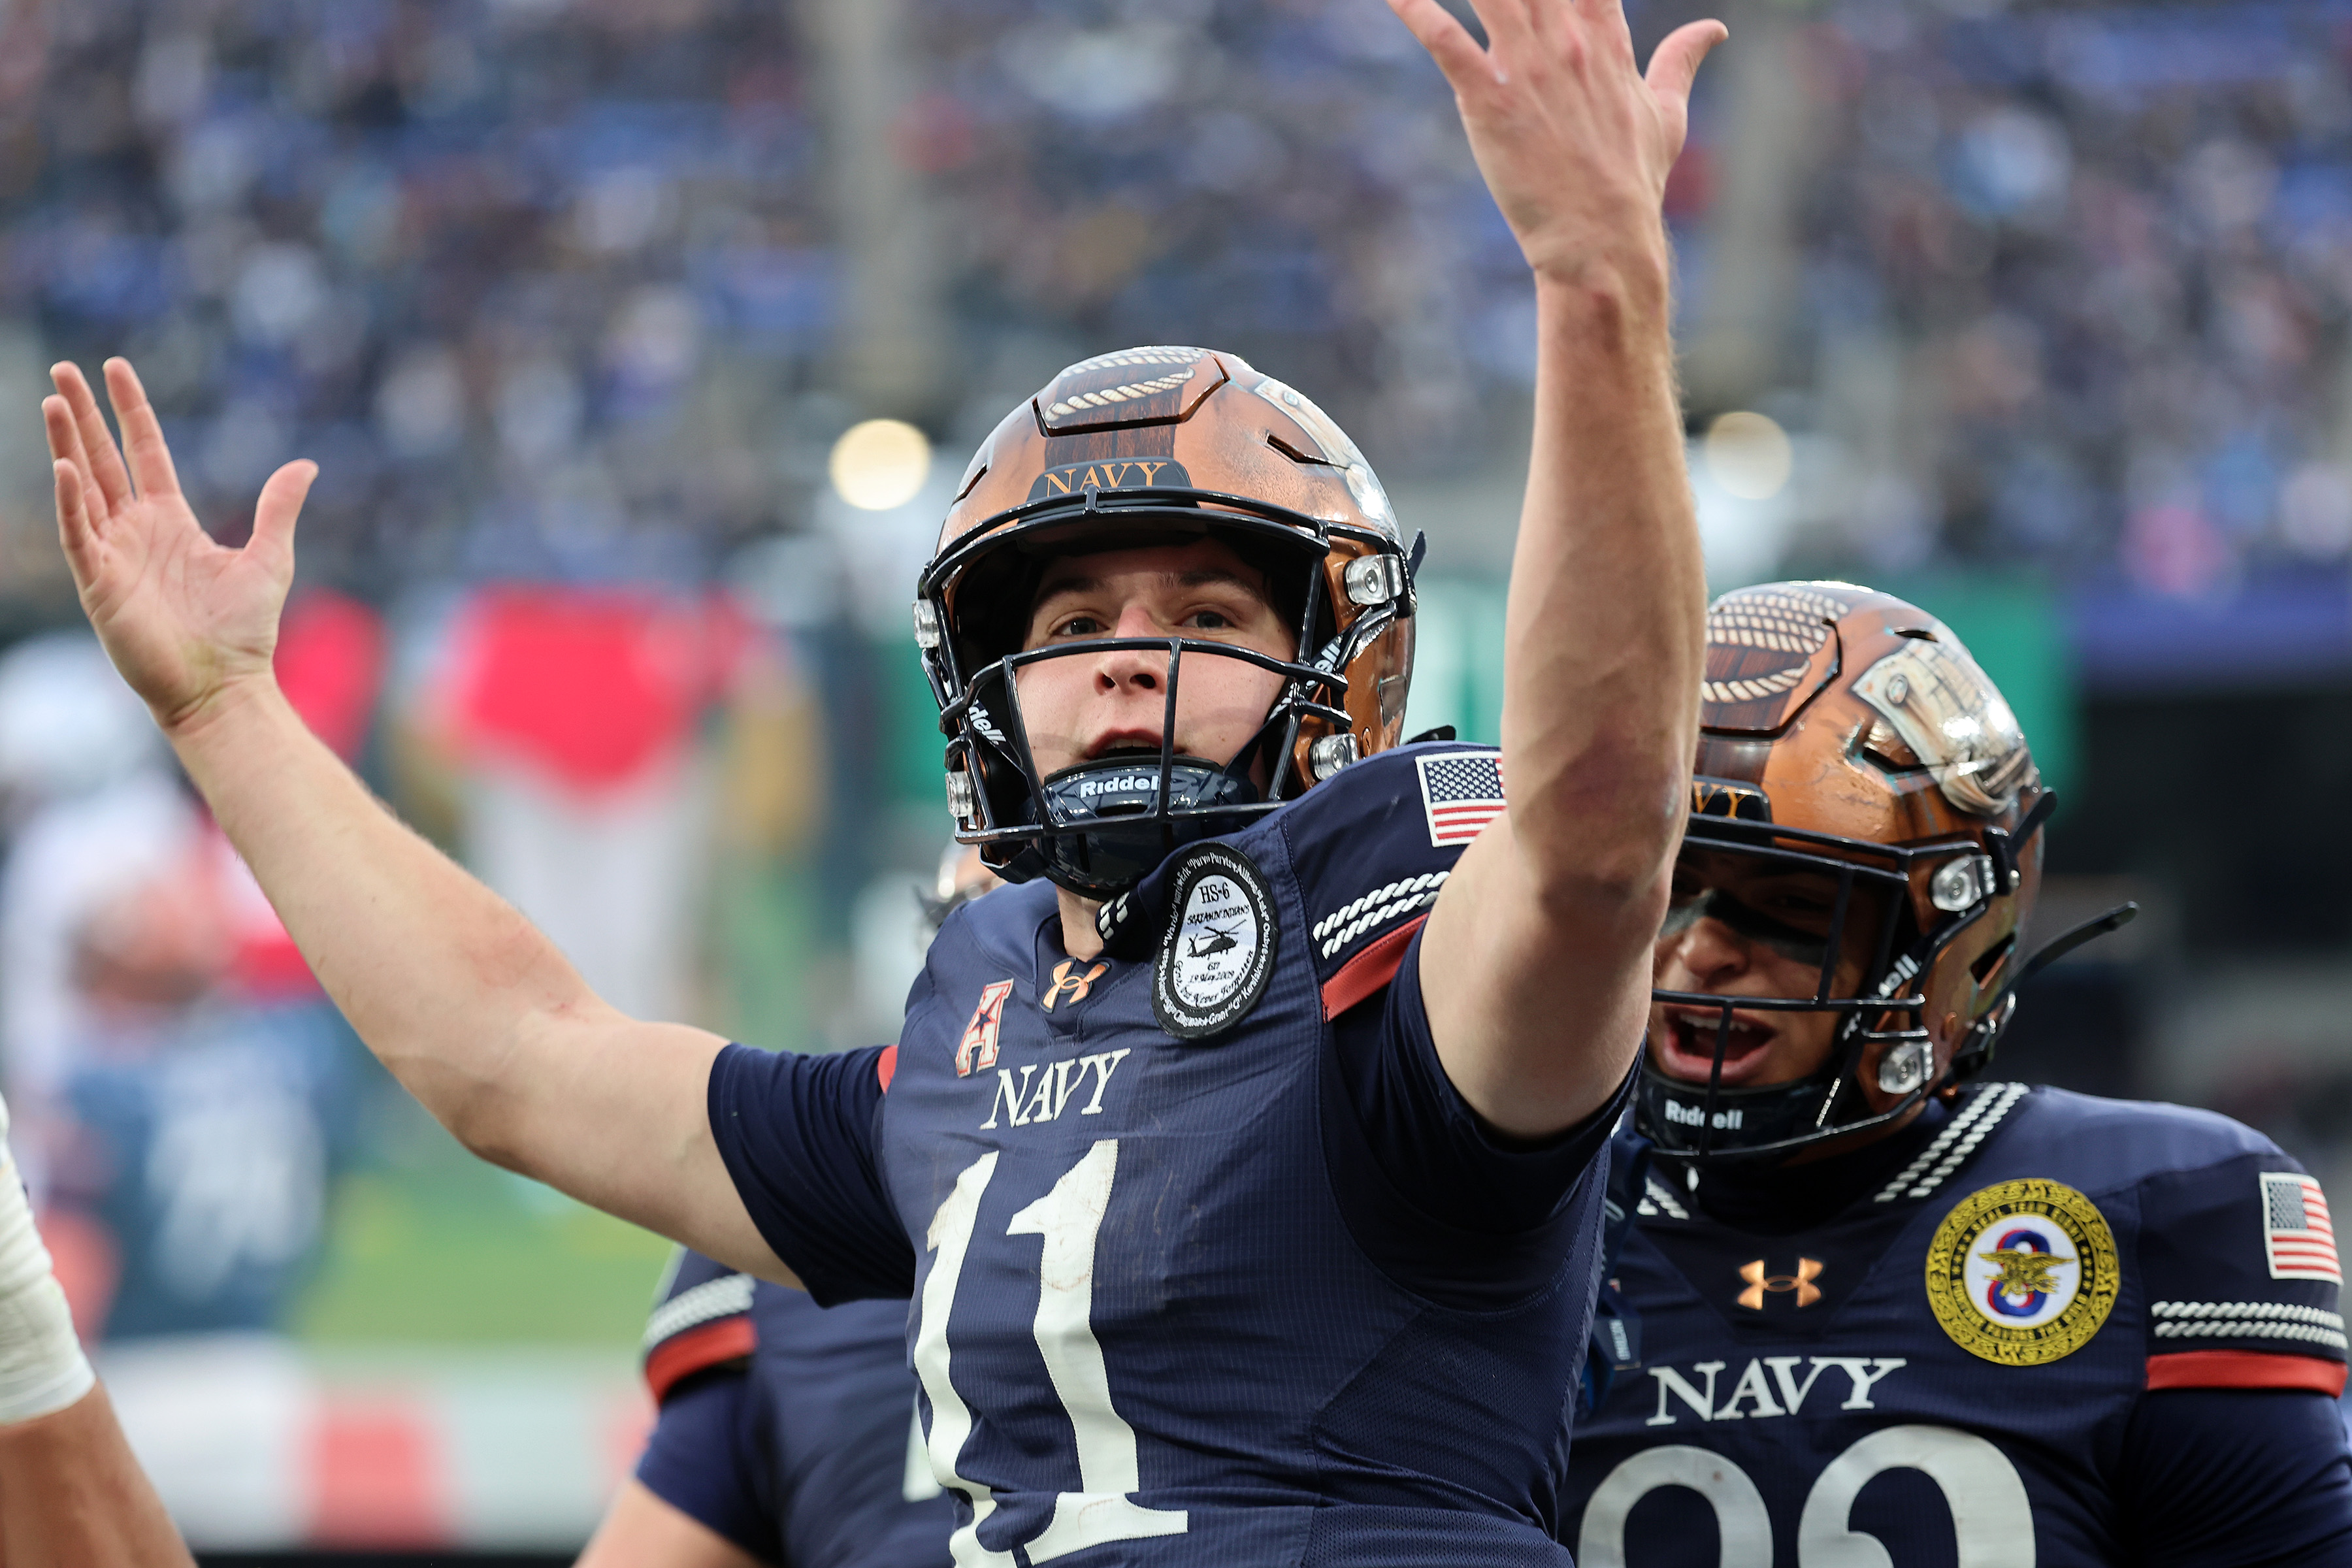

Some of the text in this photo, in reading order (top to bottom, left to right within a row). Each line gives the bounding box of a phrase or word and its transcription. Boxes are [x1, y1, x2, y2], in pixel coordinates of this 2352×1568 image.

[1045, 462, 1168, 498] NAVY
[1080, 775, 1160, 799] Riddel
[1692, 781, 1754, 821] VY
[1198, 882, 1230, 904] HS-6
[980, 1048, 1132, 1130] NAVY
[915, 1139, 1188, 1568] 11
[1647, 1357, 1906, 1426] NAVY
